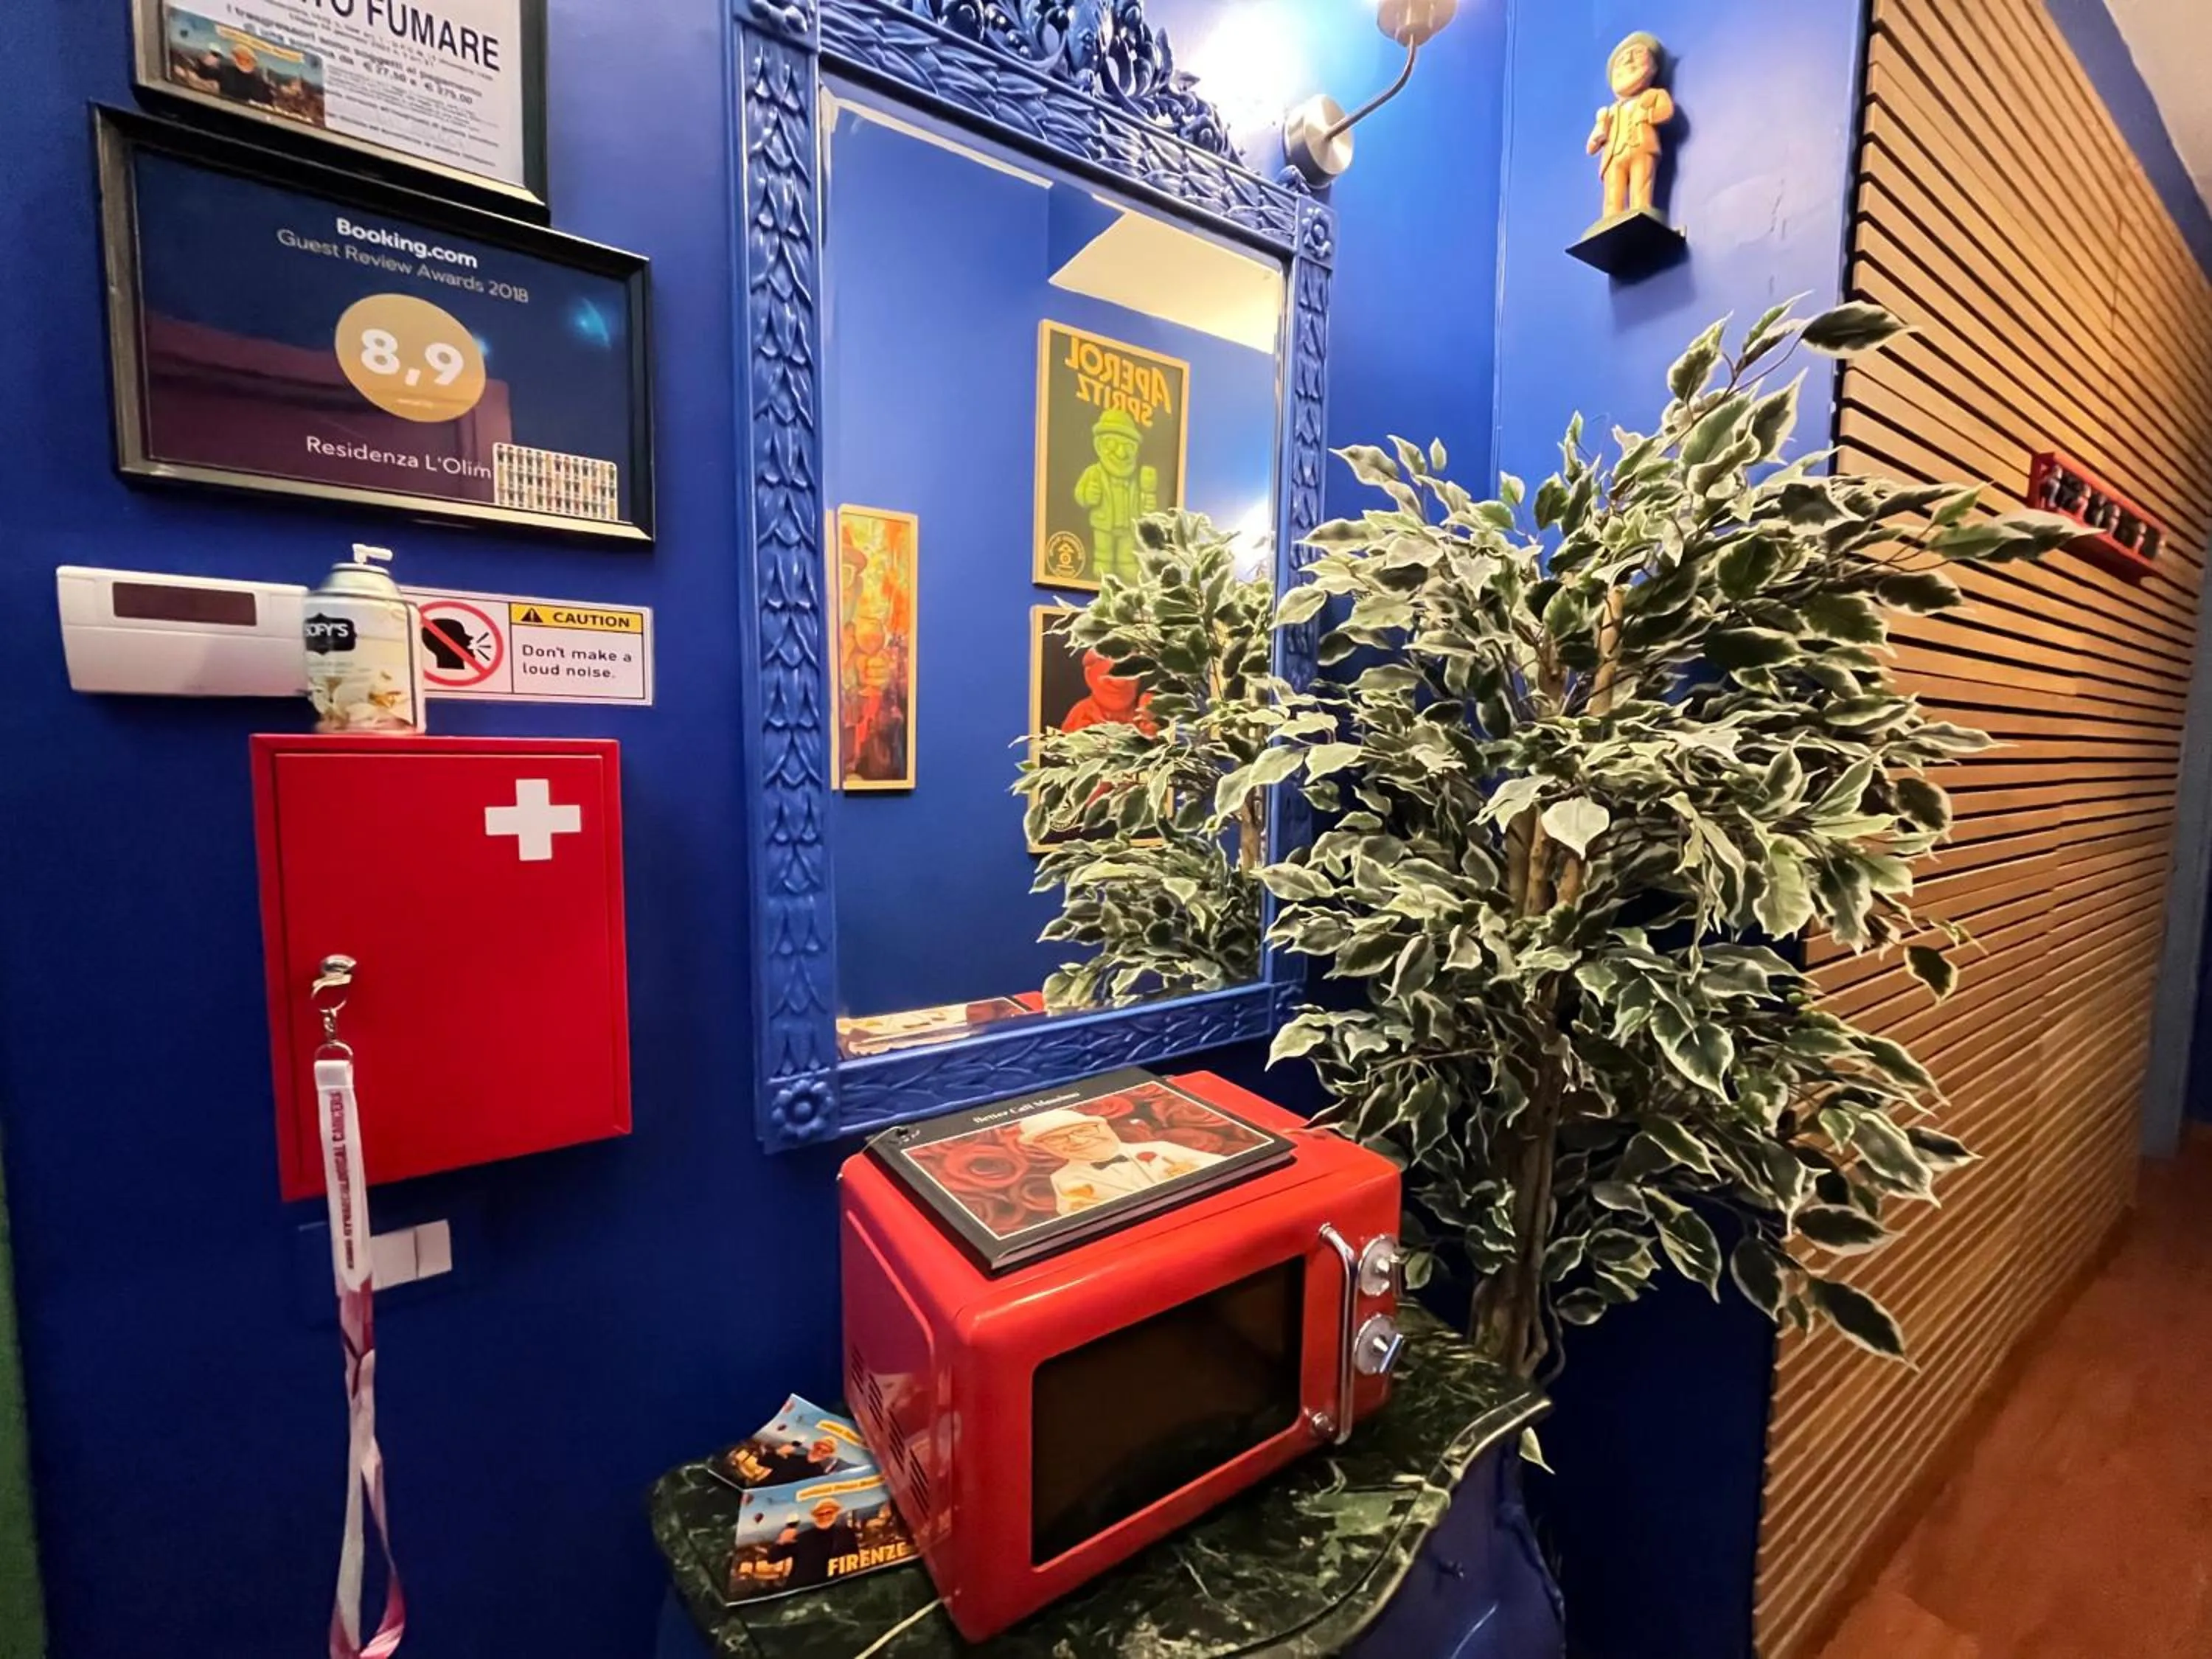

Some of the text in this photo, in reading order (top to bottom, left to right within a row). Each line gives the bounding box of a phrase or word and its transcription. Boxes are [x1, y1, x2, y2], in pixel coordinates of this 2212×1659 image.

[367, 0, 501, 72] FUMARE
[335, 217, 479, 269] Booking.com
[276, 228, 529, 304] Guest Review Awards 2018
[361, 328, 464, 386] 8,9
[306, 435, 419, 468] Residenza
[553, 611, 630, 627] CAUTION
[522, 644, 632, 662] Don't make a
[523, 661, 616, 678] loud noise.
[827, 1541, 908, 1577] FIRENZE
